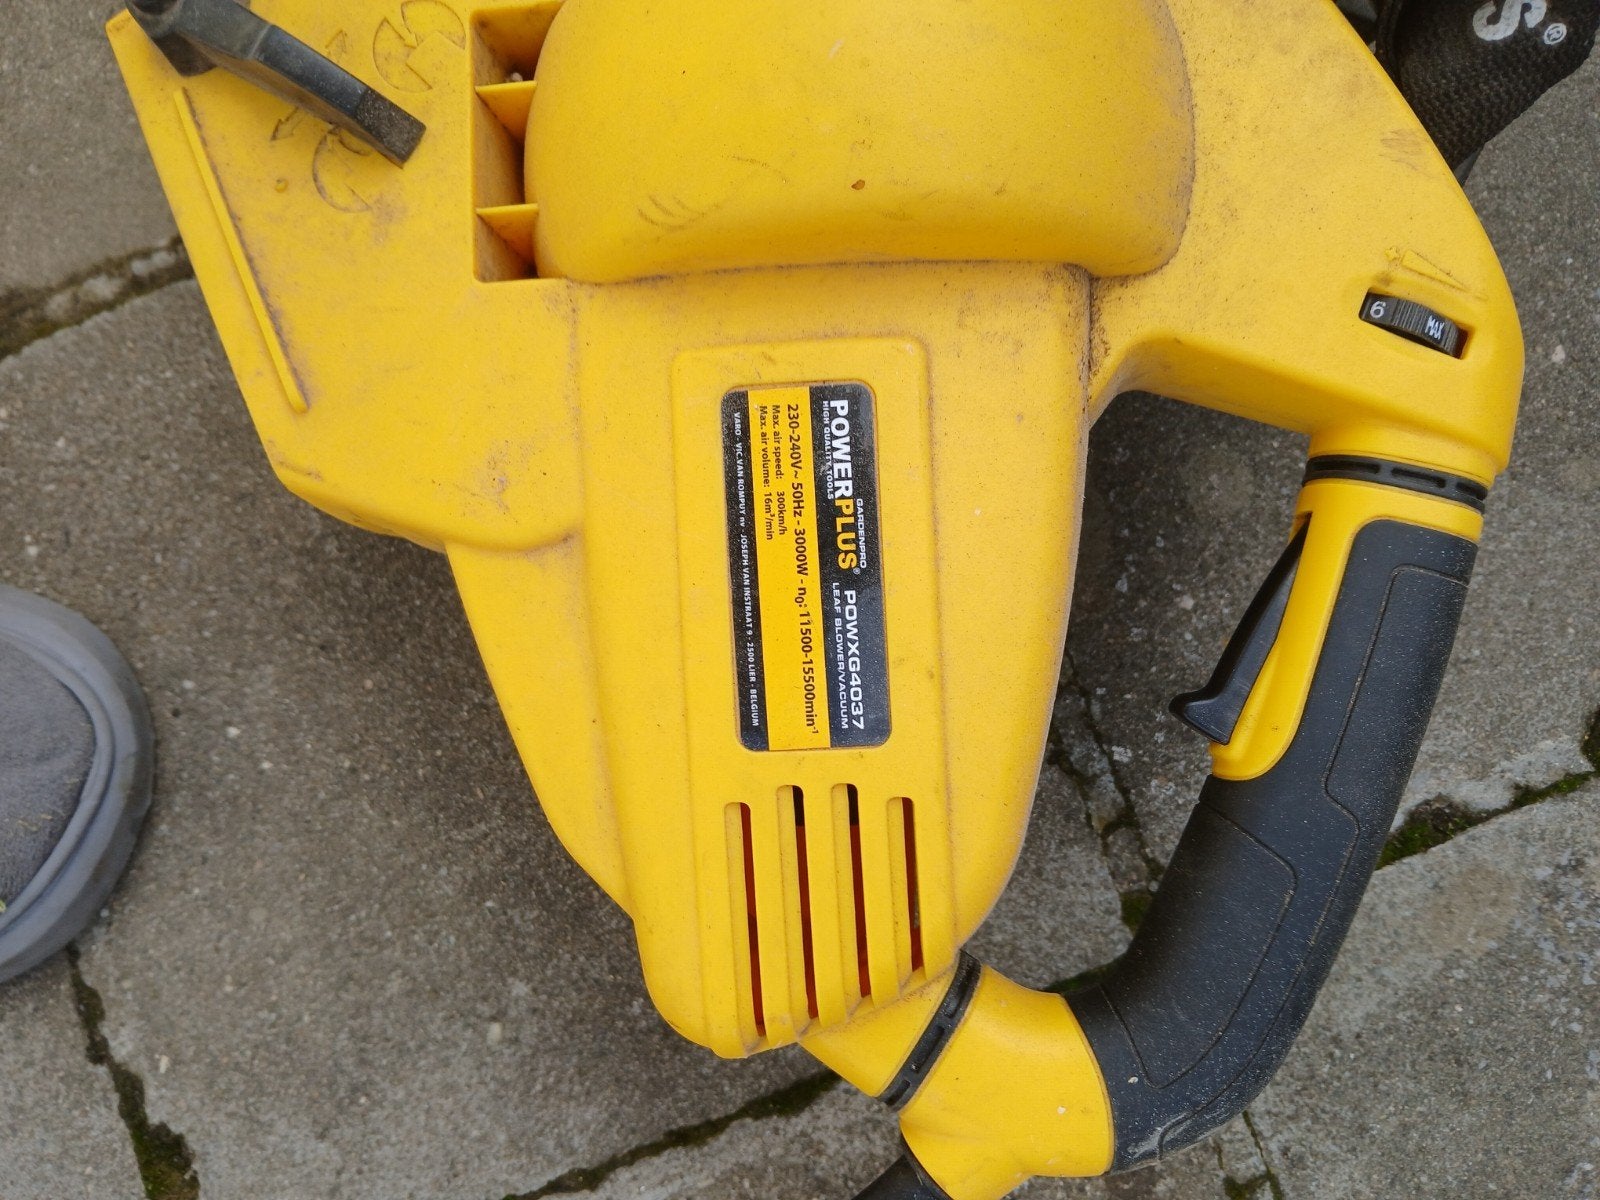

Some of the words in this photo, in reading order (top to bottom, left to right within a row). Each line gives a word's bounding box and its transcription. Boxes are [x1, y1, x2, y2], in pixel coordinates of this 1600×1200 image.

[1370, 301, 1387, 319] 6
[1425, 315, 1445, 340] MAX
[759, 406, 768, 429] Max.
[772, 405, 780, 429] Max.
[761, 432, 769, 444] air
[773, 431, 782, 444] air
[824, 427, 832, 467] QUALITY
[761, 447, 772, 487] volume:
[772, 447, 784, 479] speed:
[737, 479, 746, 514] ROMPUY
[776, 491, 787, 535] 300km/h
[792, 482, 804, 517] 50Hz
[740, 517, 745, 527] nv
[857, 499, 866, 568] GARDENPRO
[740, 534, 749, 565] JOSEPH
[795, 529, 808, 576] 3000W
[744, 587, 752, 627] INSTRAAT
[832, 583, 841, 613] LEAF
[748, 665, 756, 682] LIER
[834, 618, 848, 728] BLOWER/VACUUM
[844, 590, 864, 729] POWXG4037
[750, 689, 759, 726] BELGIUM
